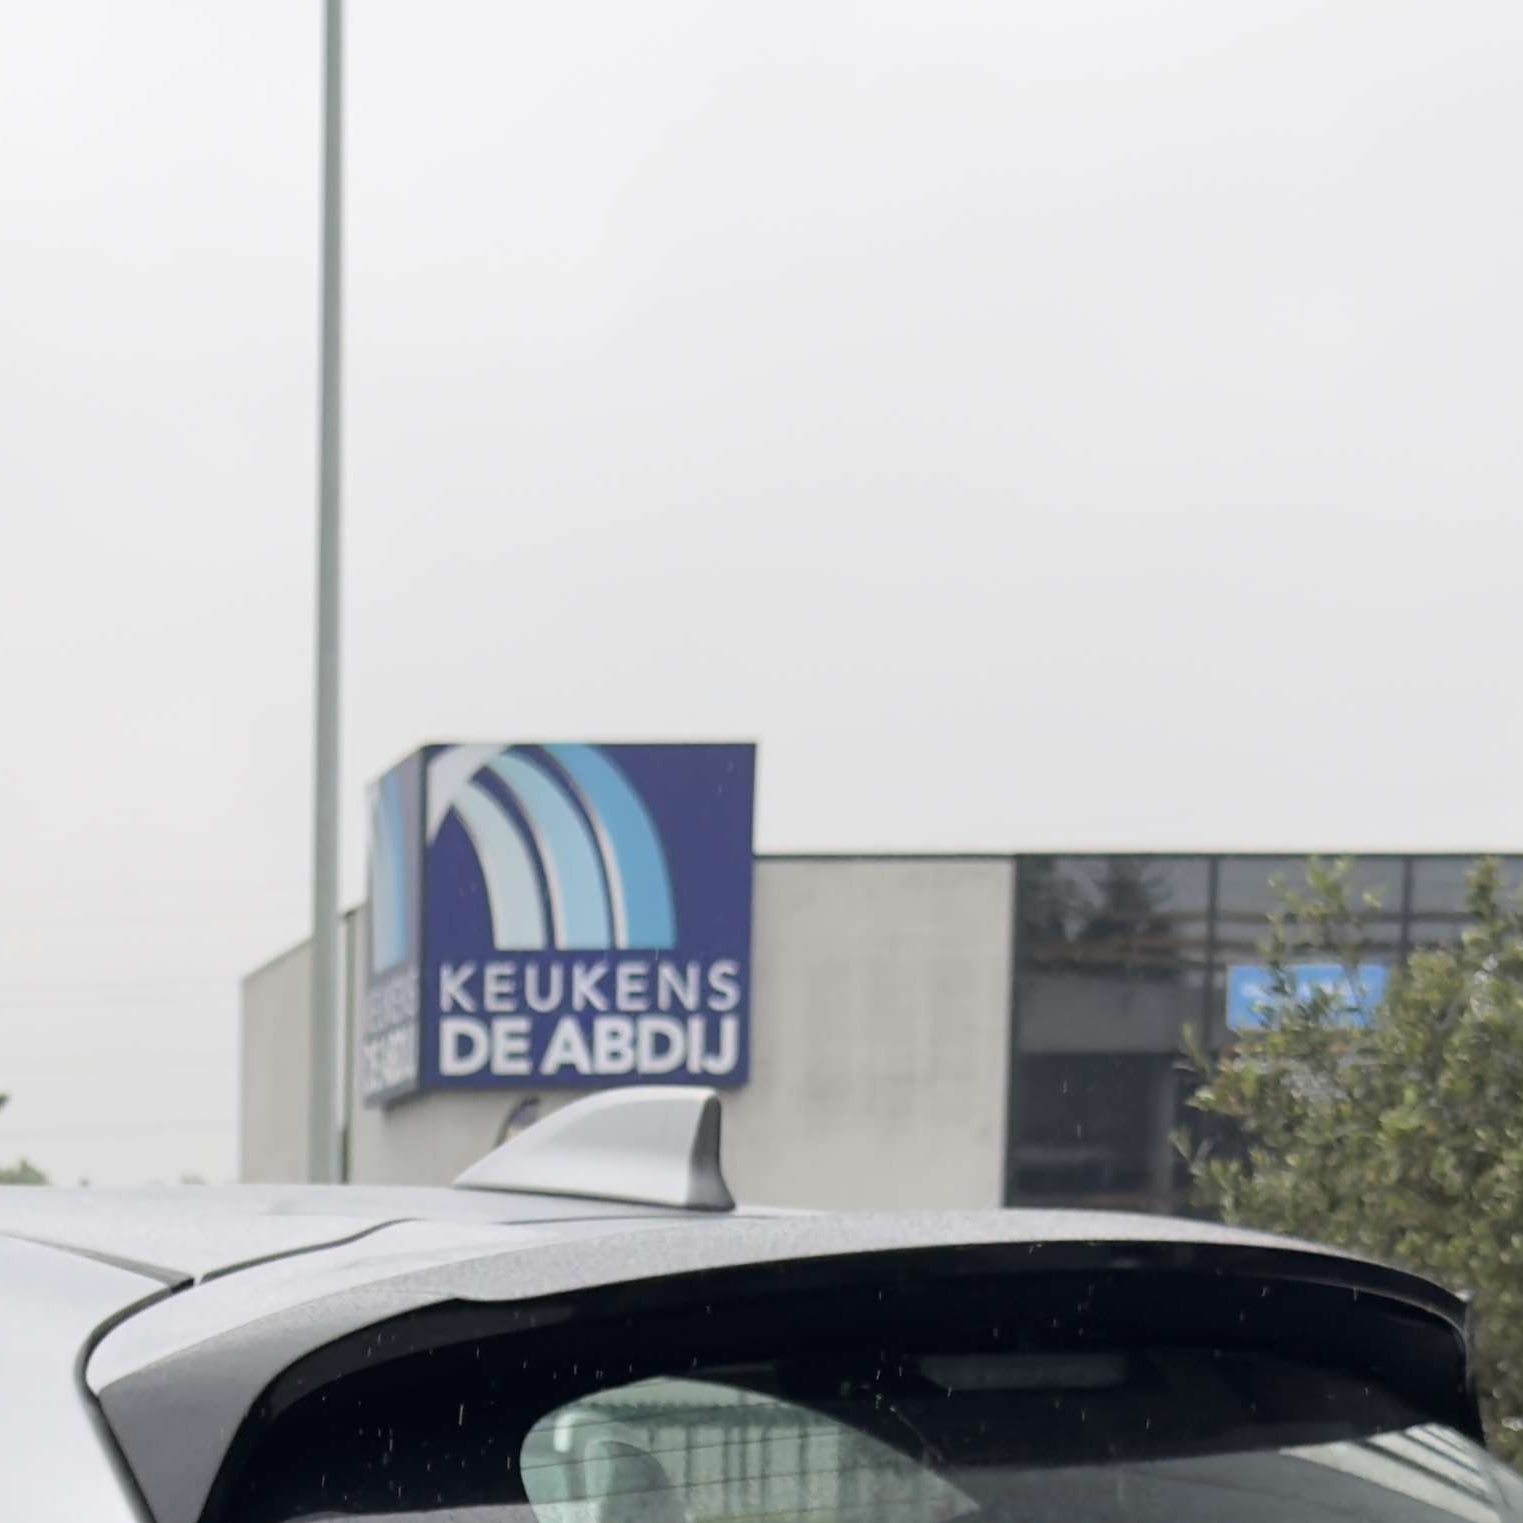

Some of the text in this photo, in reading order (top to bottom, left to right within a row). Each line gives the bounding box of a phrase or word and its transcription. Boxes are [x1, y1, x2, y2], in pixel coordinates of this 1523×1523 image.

[438, 961, 743, 1013] KEUKENS
[438, 1014, 534, 1076] DE
[539, 1014, 739, 1076] ABDIJ
